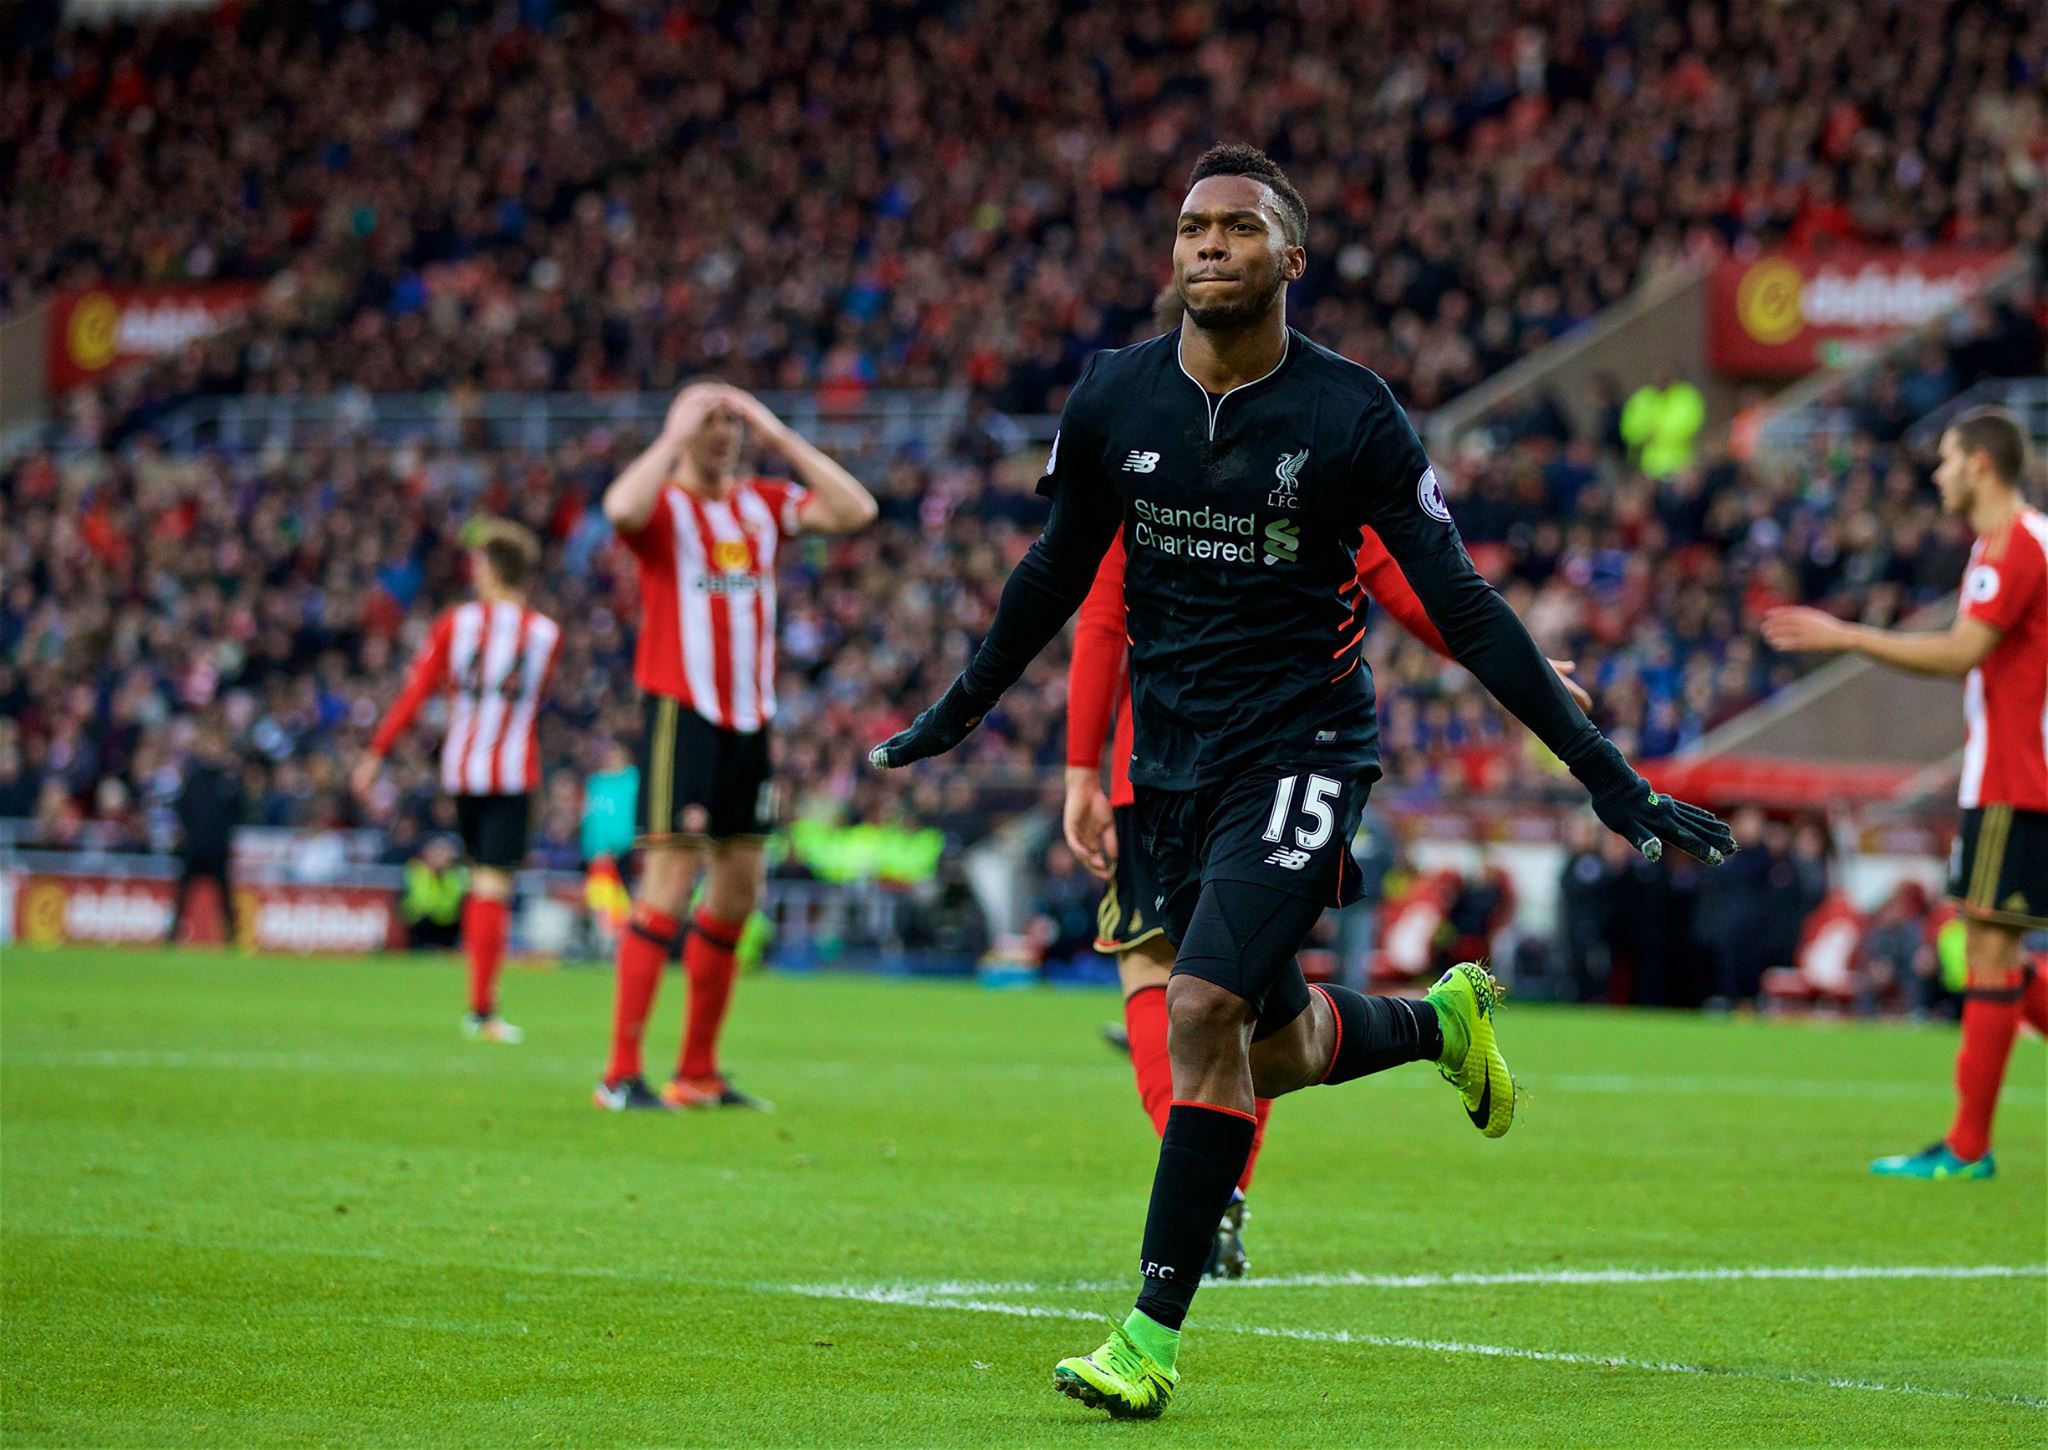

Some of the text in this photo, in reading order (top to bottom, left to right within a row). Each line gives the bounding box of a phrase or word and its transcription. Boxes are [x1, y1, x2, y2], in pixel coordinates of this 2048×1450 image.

[1135, 499, 1255, 536] Standard
[1136, 522, 1255, 563] Chartered
[1262, 774, 1342, 850] 15
